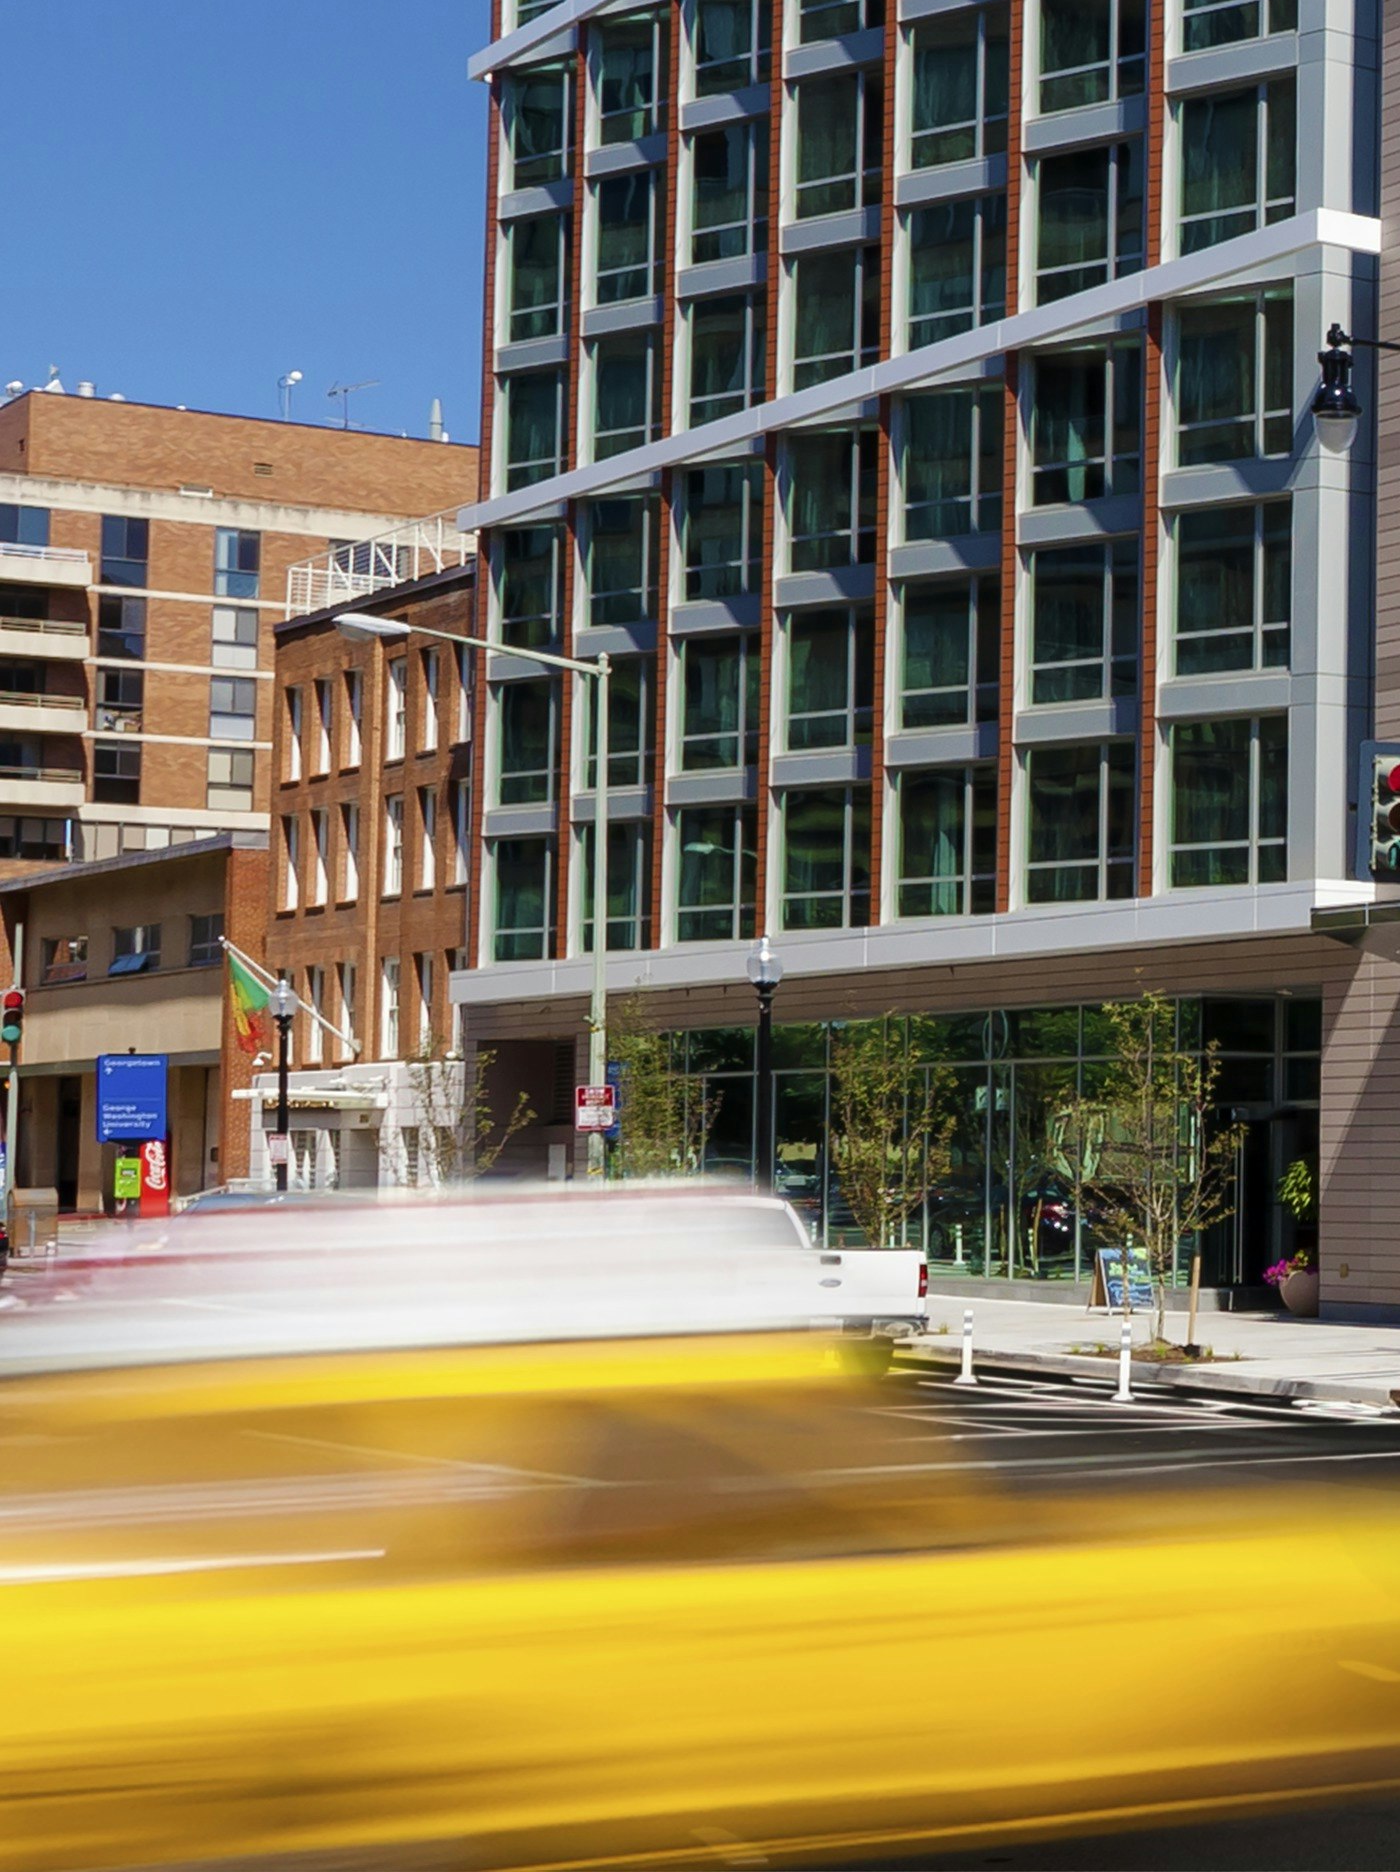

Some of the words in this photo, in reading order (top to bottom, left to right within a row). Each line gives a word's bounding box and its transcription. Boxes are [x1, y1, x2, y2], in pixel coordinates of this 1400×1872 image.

[103, 1058, 161, 1068] Georgetown
[102, 1104, 137, 1113] George
[103, 1112, 158, 1121] Washington
[102, 1121, 152, 1129] University
